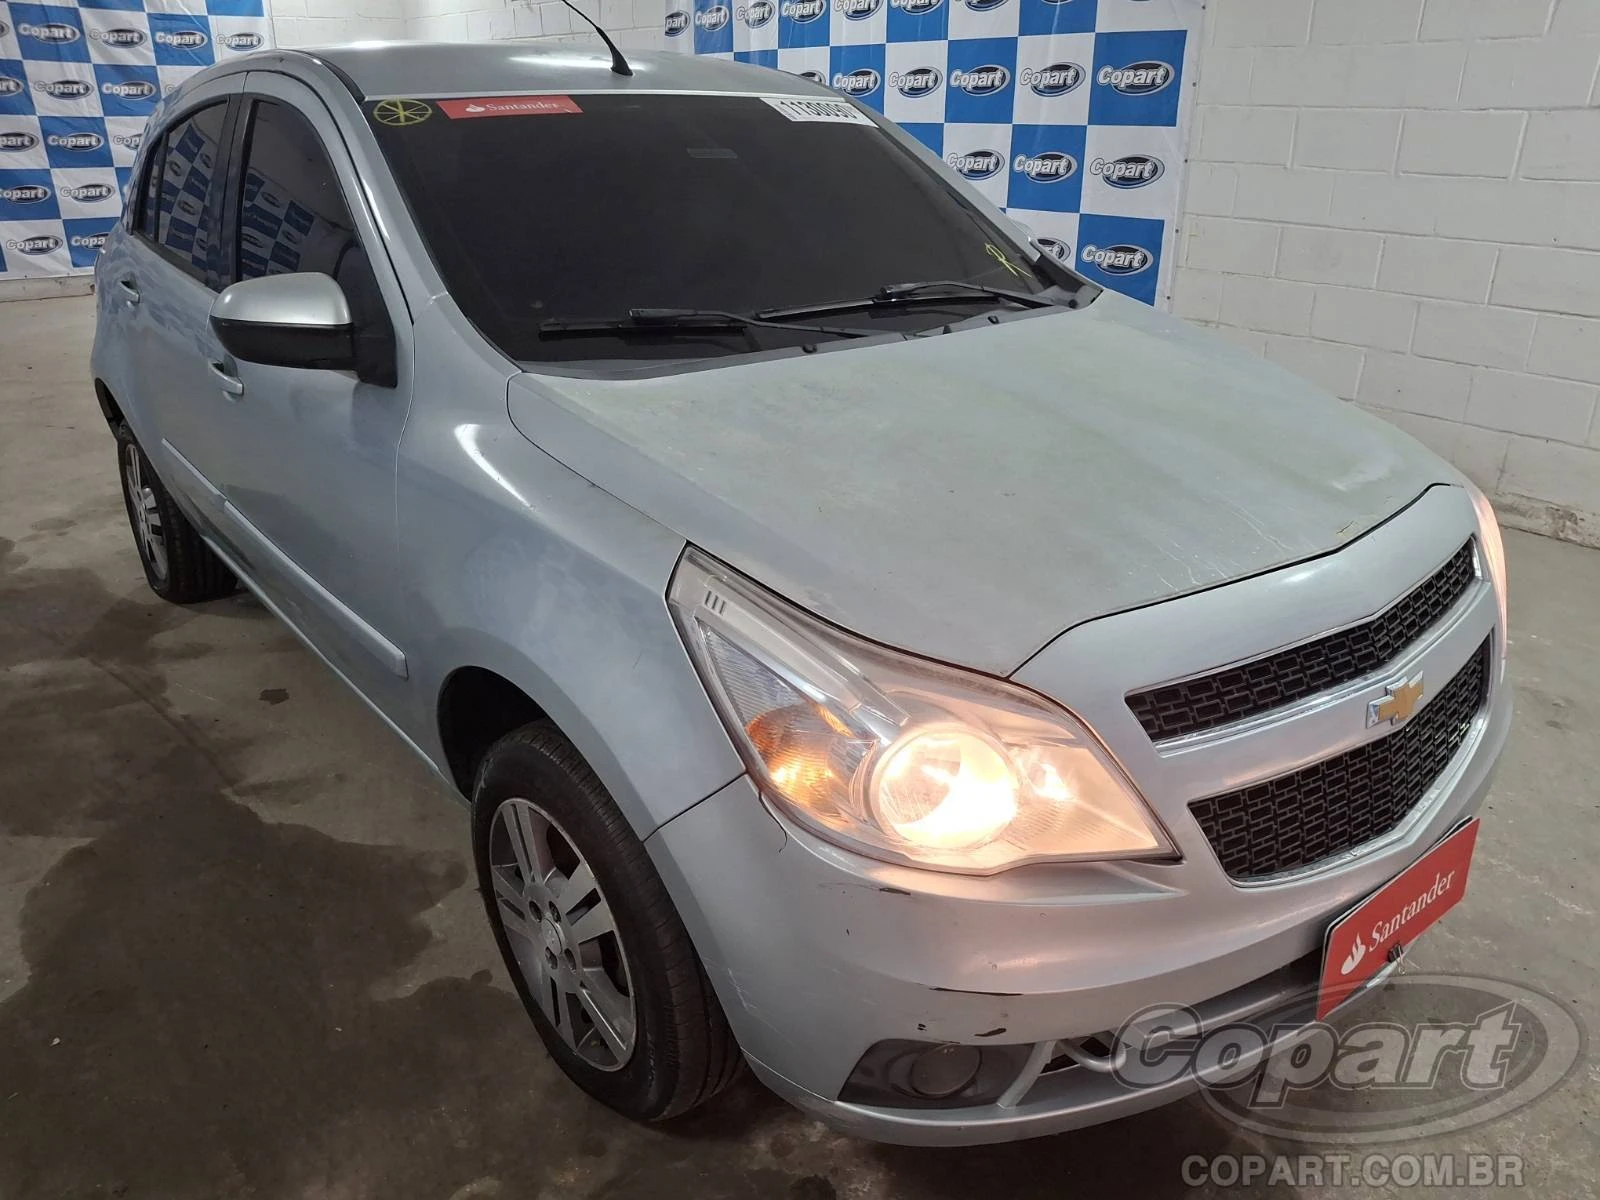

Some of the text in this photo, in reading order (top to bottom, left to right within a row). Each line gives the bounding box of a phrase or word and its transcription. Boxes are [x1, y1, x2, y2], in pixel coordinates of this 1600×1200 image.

[735, 5, 771, 21] Copart
[781, 1, 820, 17] Copart
[694, 10, 726, 25] Copart
[18, 23, 73, 41] Copart
[89, 29, 141, 44] Copart
[155, 31, 203, 46] Copart
[216, 33, 260, 49] Copart
[833, 73, 875, 92] Copart
[888, 71, 935, 92] Copart
[950, 69, 1004, 90] Copart
[1019, 67, 1077, 89] Copart
[1097, 65, 1165, 89] Copart
[34, 80, 86, 94] Copart
[102, 82, 150, 97] Copart
[486, 101, 559, 112] Santander
[48, 135, 98, 148] Copart
[947, 152, 998, 176] Copart
[1014, 154, 1069, 177] Copart
[1089, 158, 1153, 182] Copart
[60, 186, 108, 200] Copart
[6, 238, 54, 252] Copart
[1082, 245, 1144, 270] Copart
[1369, 869, 1456, 953] Santander
